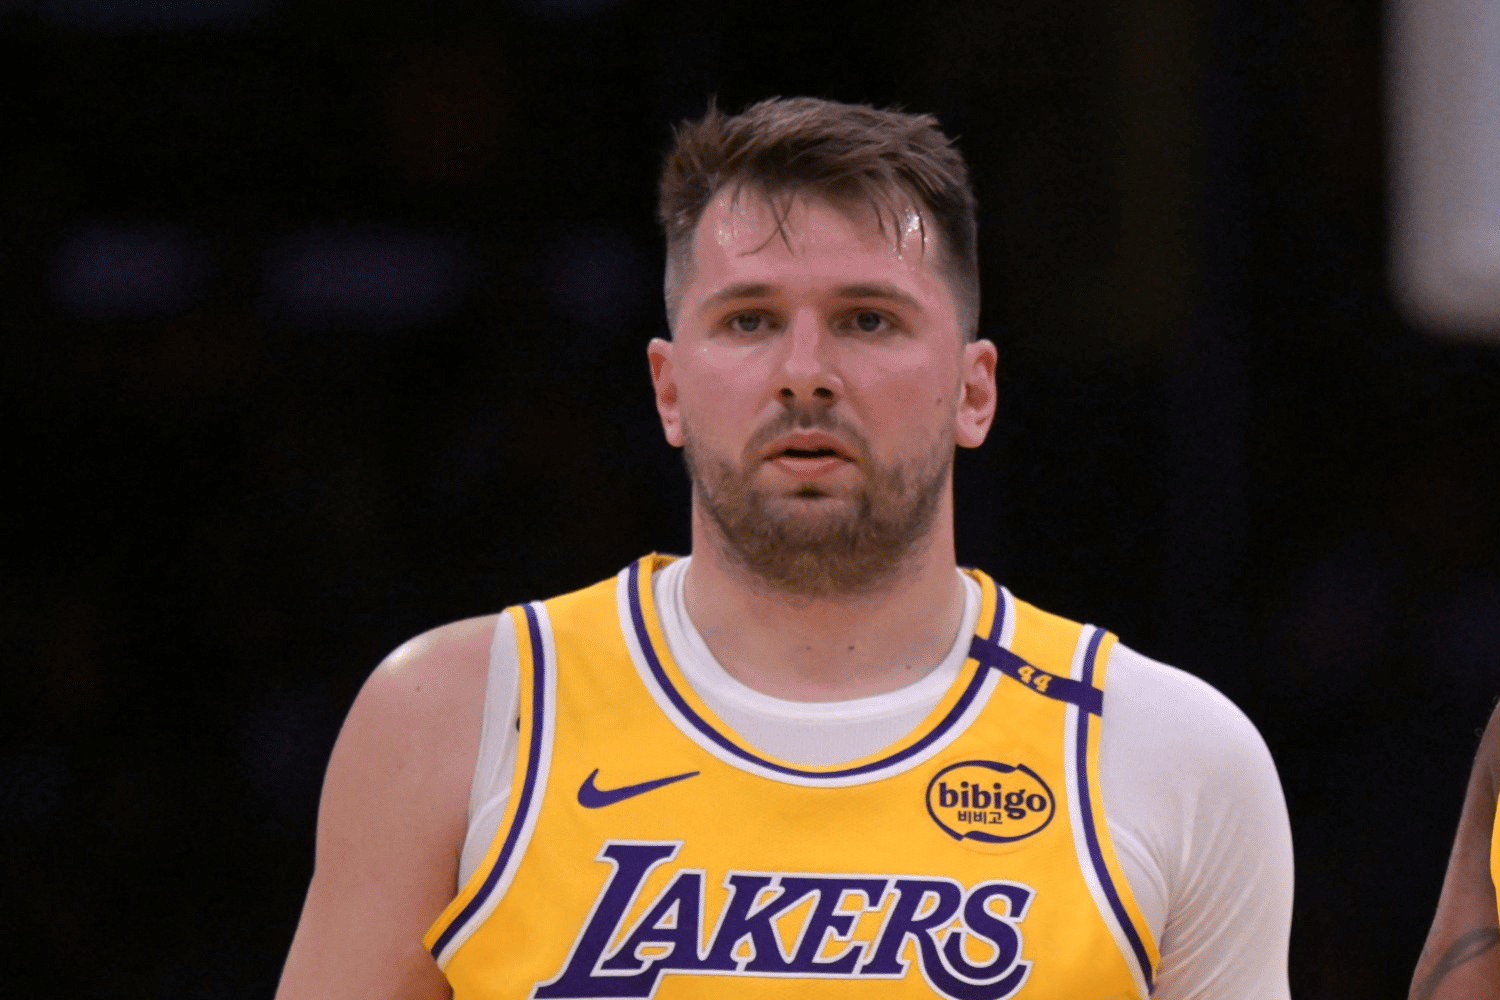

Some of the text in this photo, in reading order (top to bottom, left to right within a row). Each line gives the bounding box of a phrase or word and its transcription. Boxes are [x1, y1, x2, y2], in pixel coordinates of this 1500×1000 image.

[1017, 665, 1053, 693] 44
[939, 781, 1047, 820] bibigo
[958, 811, 1003, 824] 비비고
